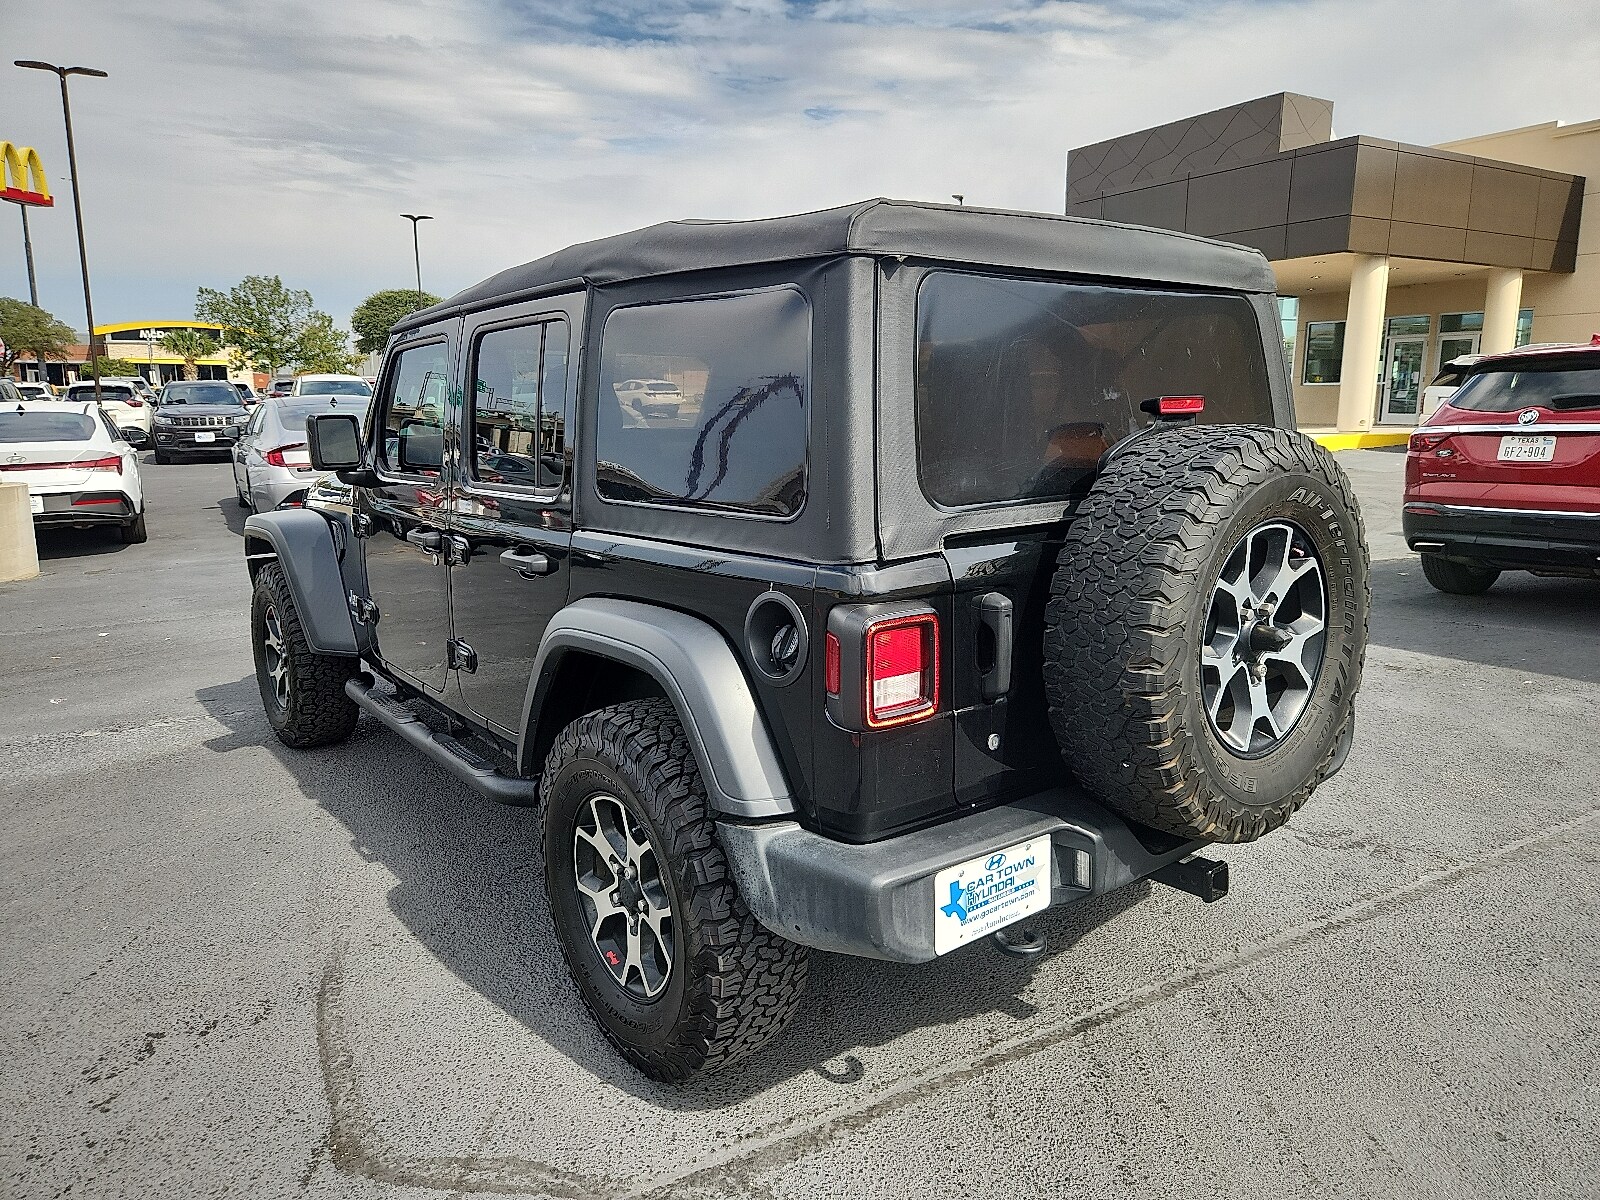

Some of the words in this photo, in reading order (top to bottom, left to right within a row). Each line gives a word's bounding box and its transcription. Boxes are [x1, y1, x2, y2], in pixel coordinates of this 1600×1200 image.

[1286, 486, 1358, 635] All-Terrain
[967, 873, 994, 892] CAR
[996, 855, 1035, 879] TOWN
[967, 875, 1015, 906] HYUNDAI
[960, 889, 1035, 927] www.gocartown.com
